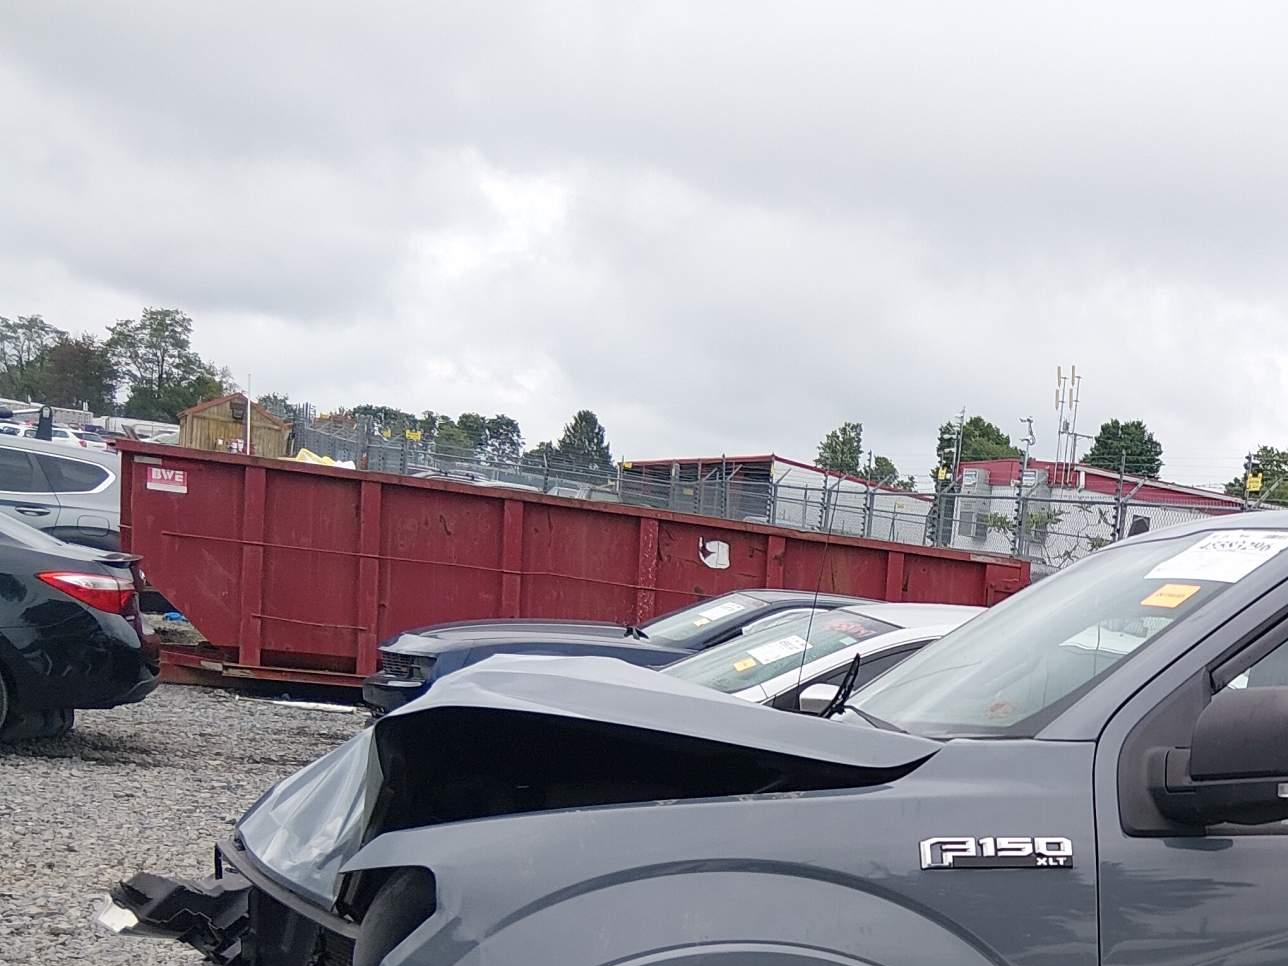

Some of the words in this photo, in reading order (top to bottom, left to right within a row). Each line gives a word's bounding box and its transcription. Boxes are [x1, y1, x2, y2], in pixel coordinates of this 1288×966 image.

[151, 467, 184, 482] BWE
[920, 836, 1073, 869] F150
[1036, 857, 1067, 866] XLT
